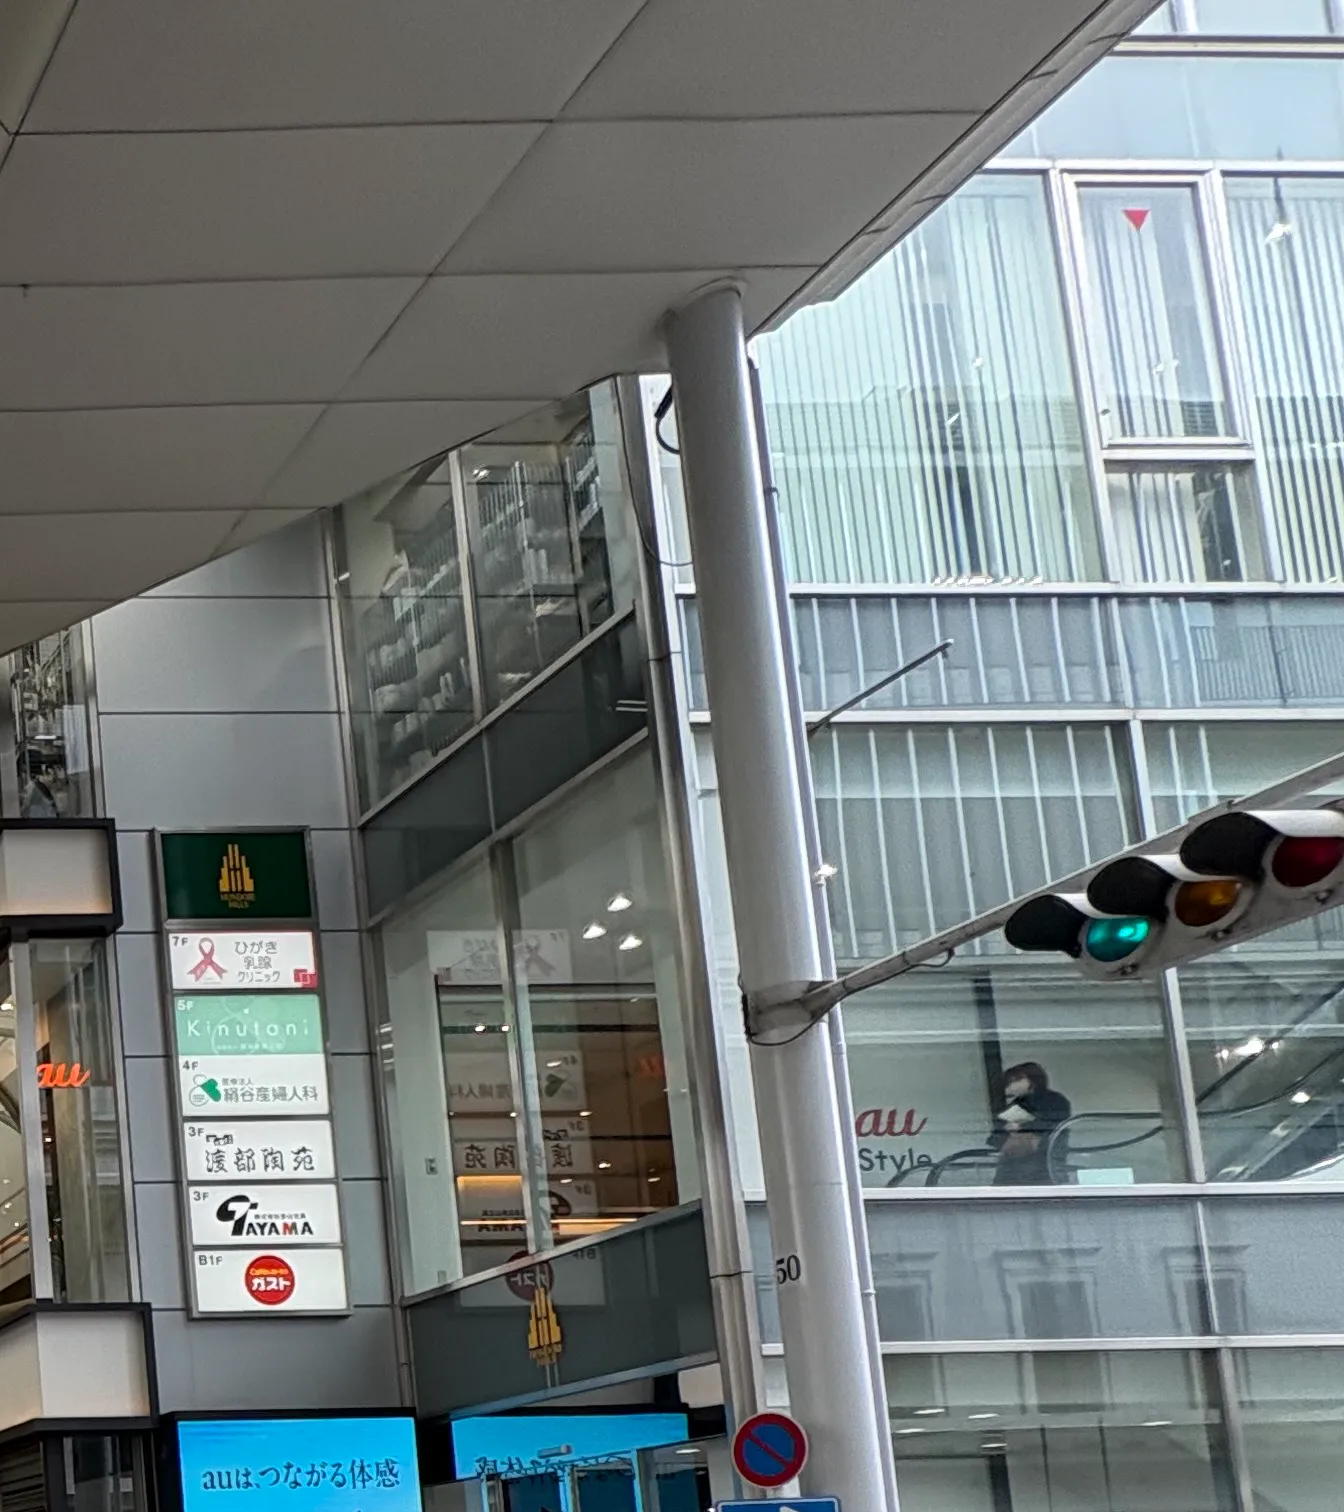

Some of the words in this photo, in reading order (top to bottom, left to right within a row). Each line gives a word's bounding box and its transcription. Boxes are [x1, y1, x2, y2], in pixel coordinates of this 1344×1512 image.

[172, 936, 189, 946] 7F
[234, 941, 278, 955] ひがき
[237, 971, 281, 983] クリニック
[187, 1019, 309, 1037] Kinutani
[182, 1061, 199, 1071] 4F
[36, 1061, 90, 1089] au
[855, 1108, 928, 1137] au
[188, 1126, 204, 1137] 3F
[859, 1148, 932, 1175] Style
[193, 1190, 209, 1201] 3F
[198, 1254, 223, 1265] B1F
[776, 1254, 801, 1285] 50
[251, 1276, 291, 1291] ガスト
[202, 1458, 401, 1490] auは、つながる体感
